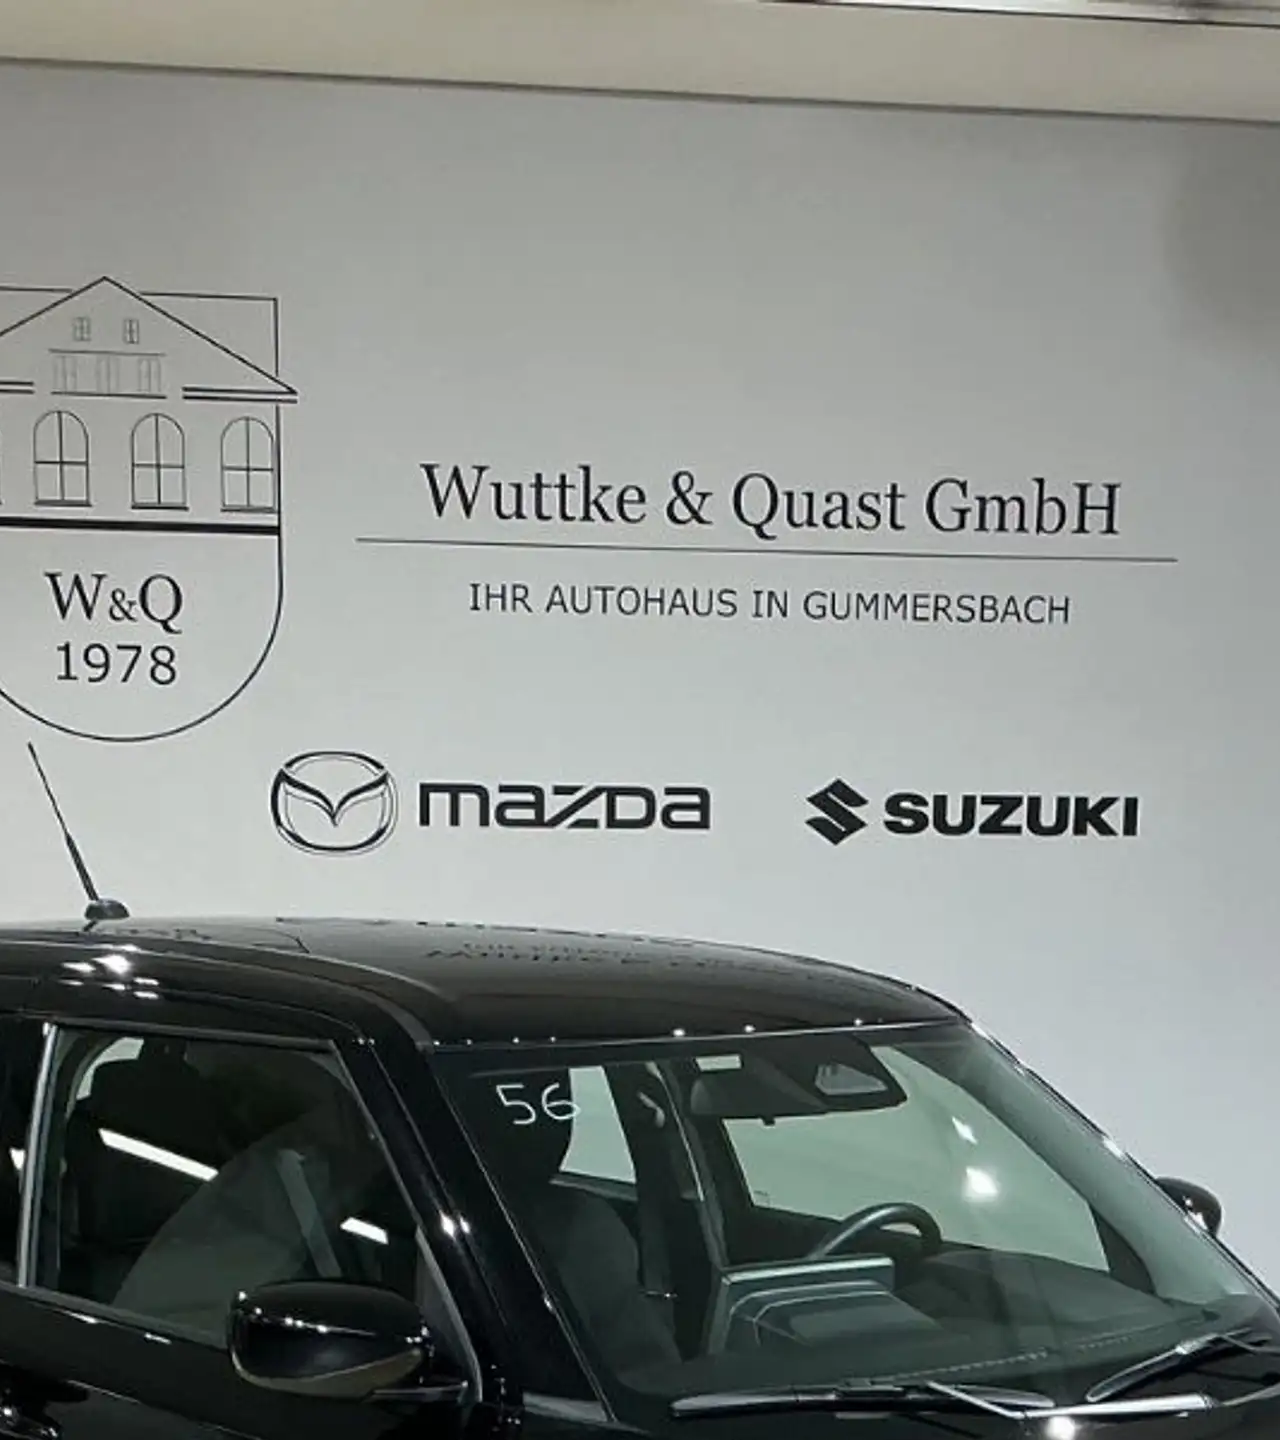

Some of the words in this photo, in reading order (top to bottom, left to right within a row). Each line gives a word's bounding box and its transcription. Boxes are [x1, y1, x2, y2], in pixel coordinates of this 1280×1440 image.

[419, 463, 647, 525] Wuttke
[665, 470, 714, 526] &
[732, 472, 907, 542] Quast
[925, 477, 1122, 536] GmbH
[44, 572, 183, 635] W&Q
[469, 582, 534, 614] IHR
[544, 583, 738, 618] AUTOHAUS
[751, 589, 788, 619] IN
[802, 590, 1070, 625] GUMMERSBACH
[56, 640, 177, 686] 1978
[882, 791, 1139, 838] SUZUKI
[496, 1081, 582, 1126] 56
